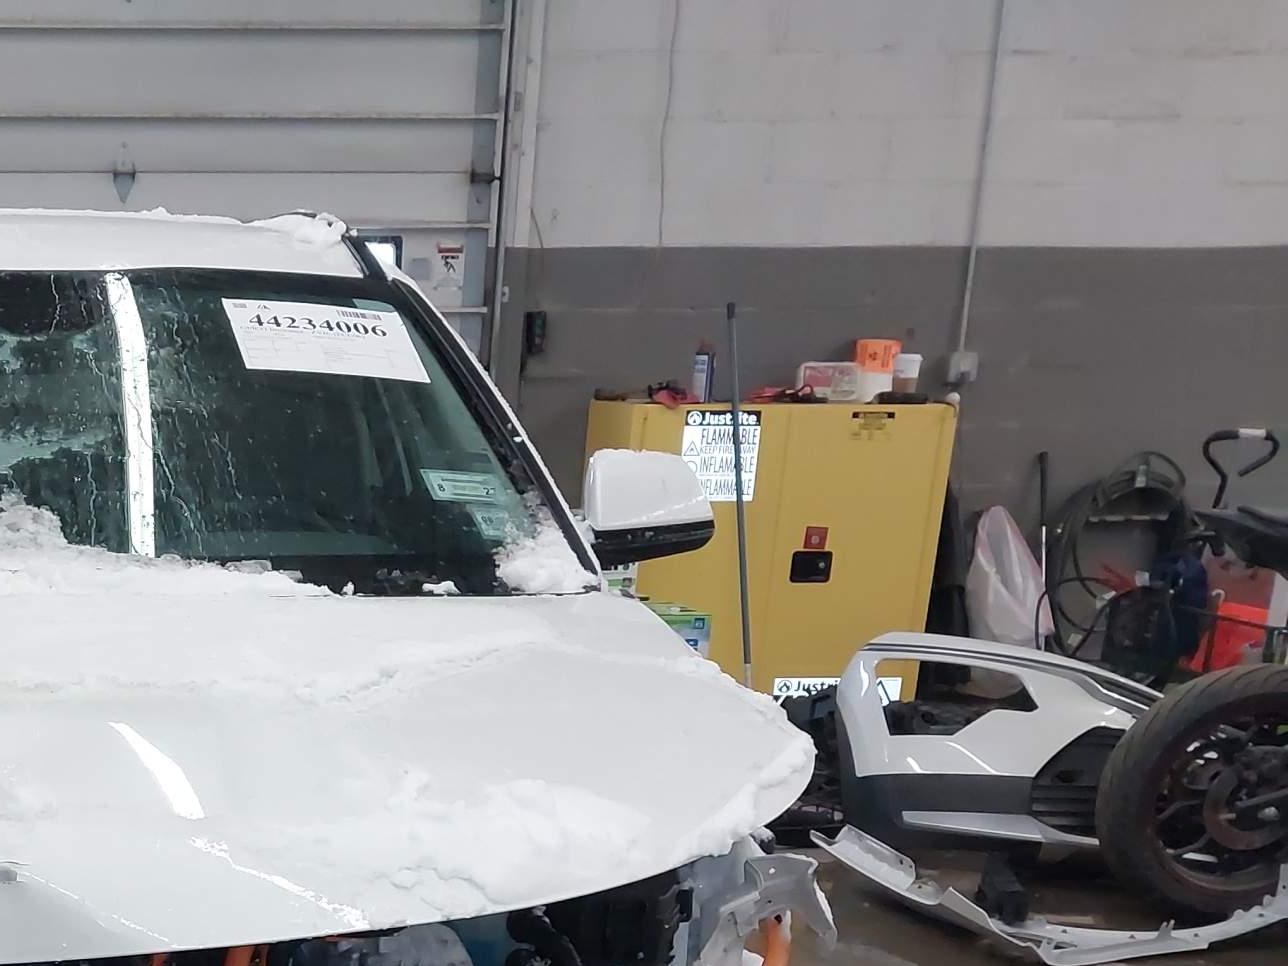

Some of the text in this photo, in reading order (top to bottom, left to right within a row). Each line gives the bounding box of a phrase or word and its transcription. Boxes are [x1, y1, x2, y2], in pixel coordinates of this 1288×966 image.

[248, 313, 388, 337] 44234006
[703, 411, 758, 425] Justite
[700, 428, 758, 445] FLAMMBLE
